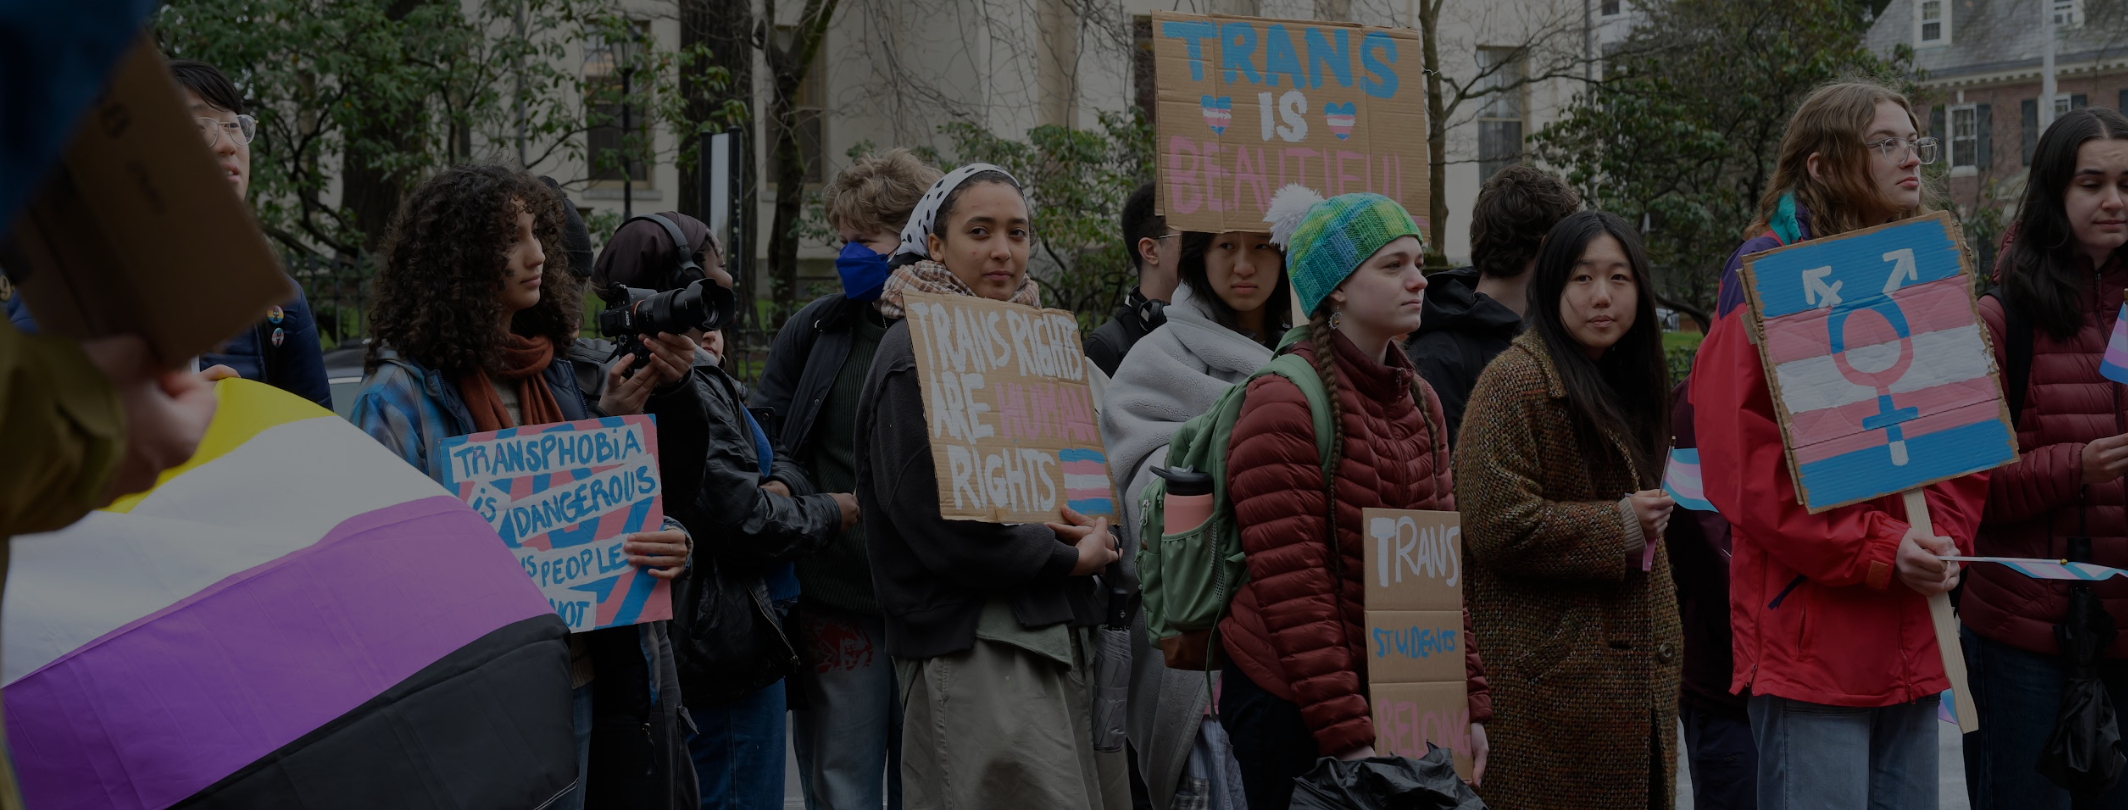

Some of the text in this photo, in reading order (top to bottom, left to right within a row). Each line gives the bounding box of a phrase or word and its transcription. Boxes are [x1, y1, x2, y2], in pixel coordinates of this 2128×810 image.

[1162, 20, 1399, 99] TRANS
[1258, 88, 1308, 142] IS
[908, 301, 1083, 381] TRANS RIGHTS
[930, 370, 1097, 445] ARE HUMAN
[513, 465, 656, 537] DANGEROUS
[946, 444, 1056, 513] RIGHTS
[541, 542, 628, 587] PEOPLE
[1370, 516, 1460, 587] TRANS
[1373, 626, 1457, 659] STUDENTS
[1377, 697, 1472, 759] BELONG
